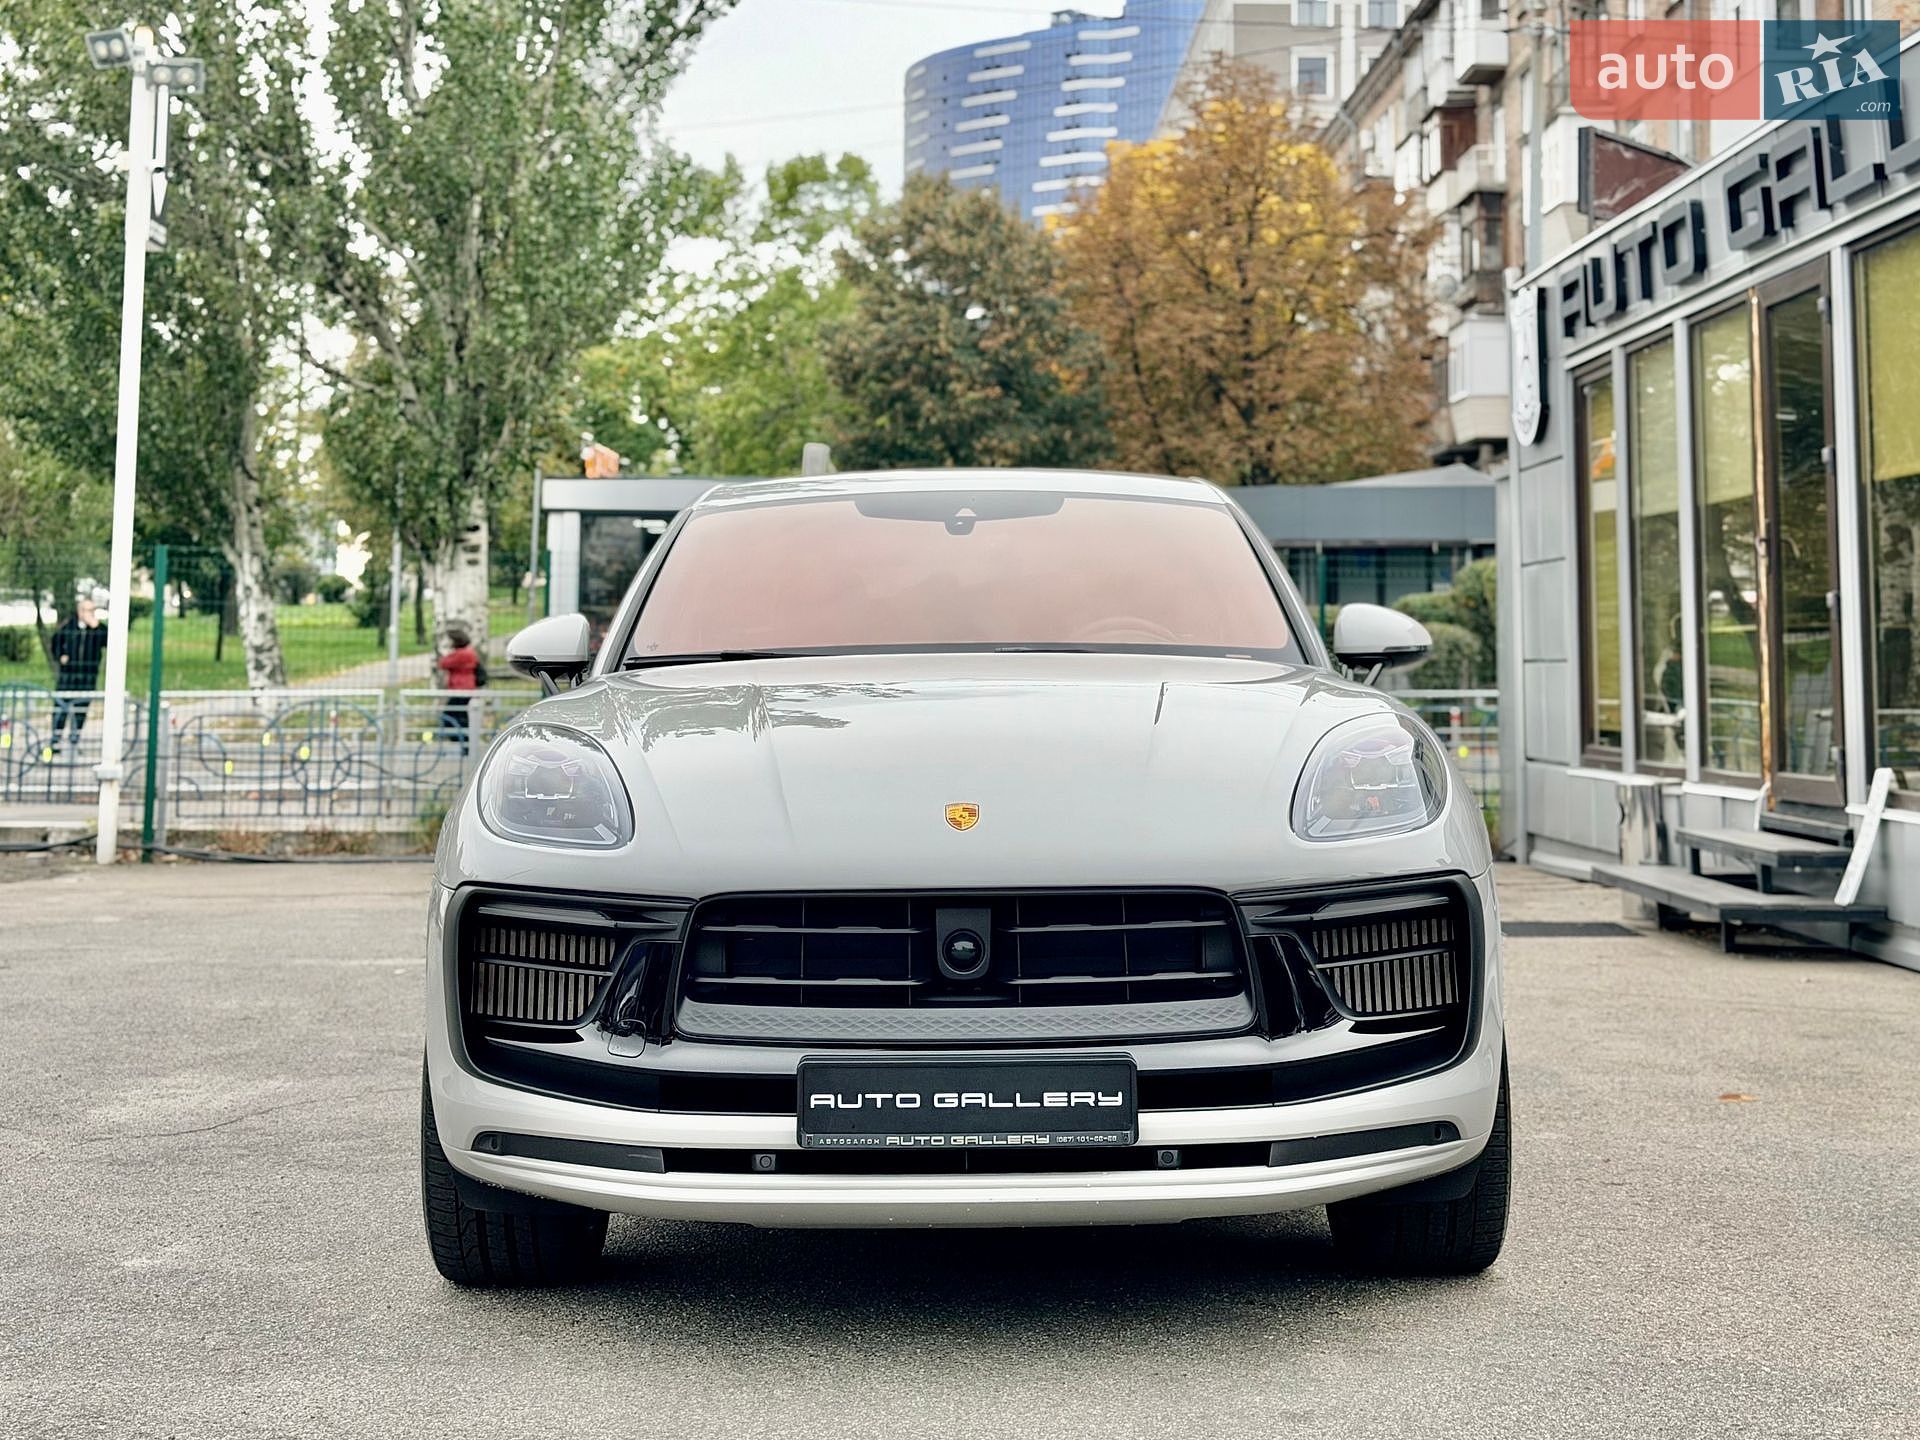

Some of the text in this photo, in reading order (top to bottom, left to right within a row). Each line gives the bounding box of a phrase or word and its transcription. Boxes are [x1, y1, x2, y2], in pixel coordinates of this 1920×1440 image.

[1559, 199, 1707, 337] AUTO
[810, 1091, 1123, 1109] AUTO GALLERY
[886, 1135, 945, 1146] AUTO
[950, 1134, 1050, 1145] GALLERY
